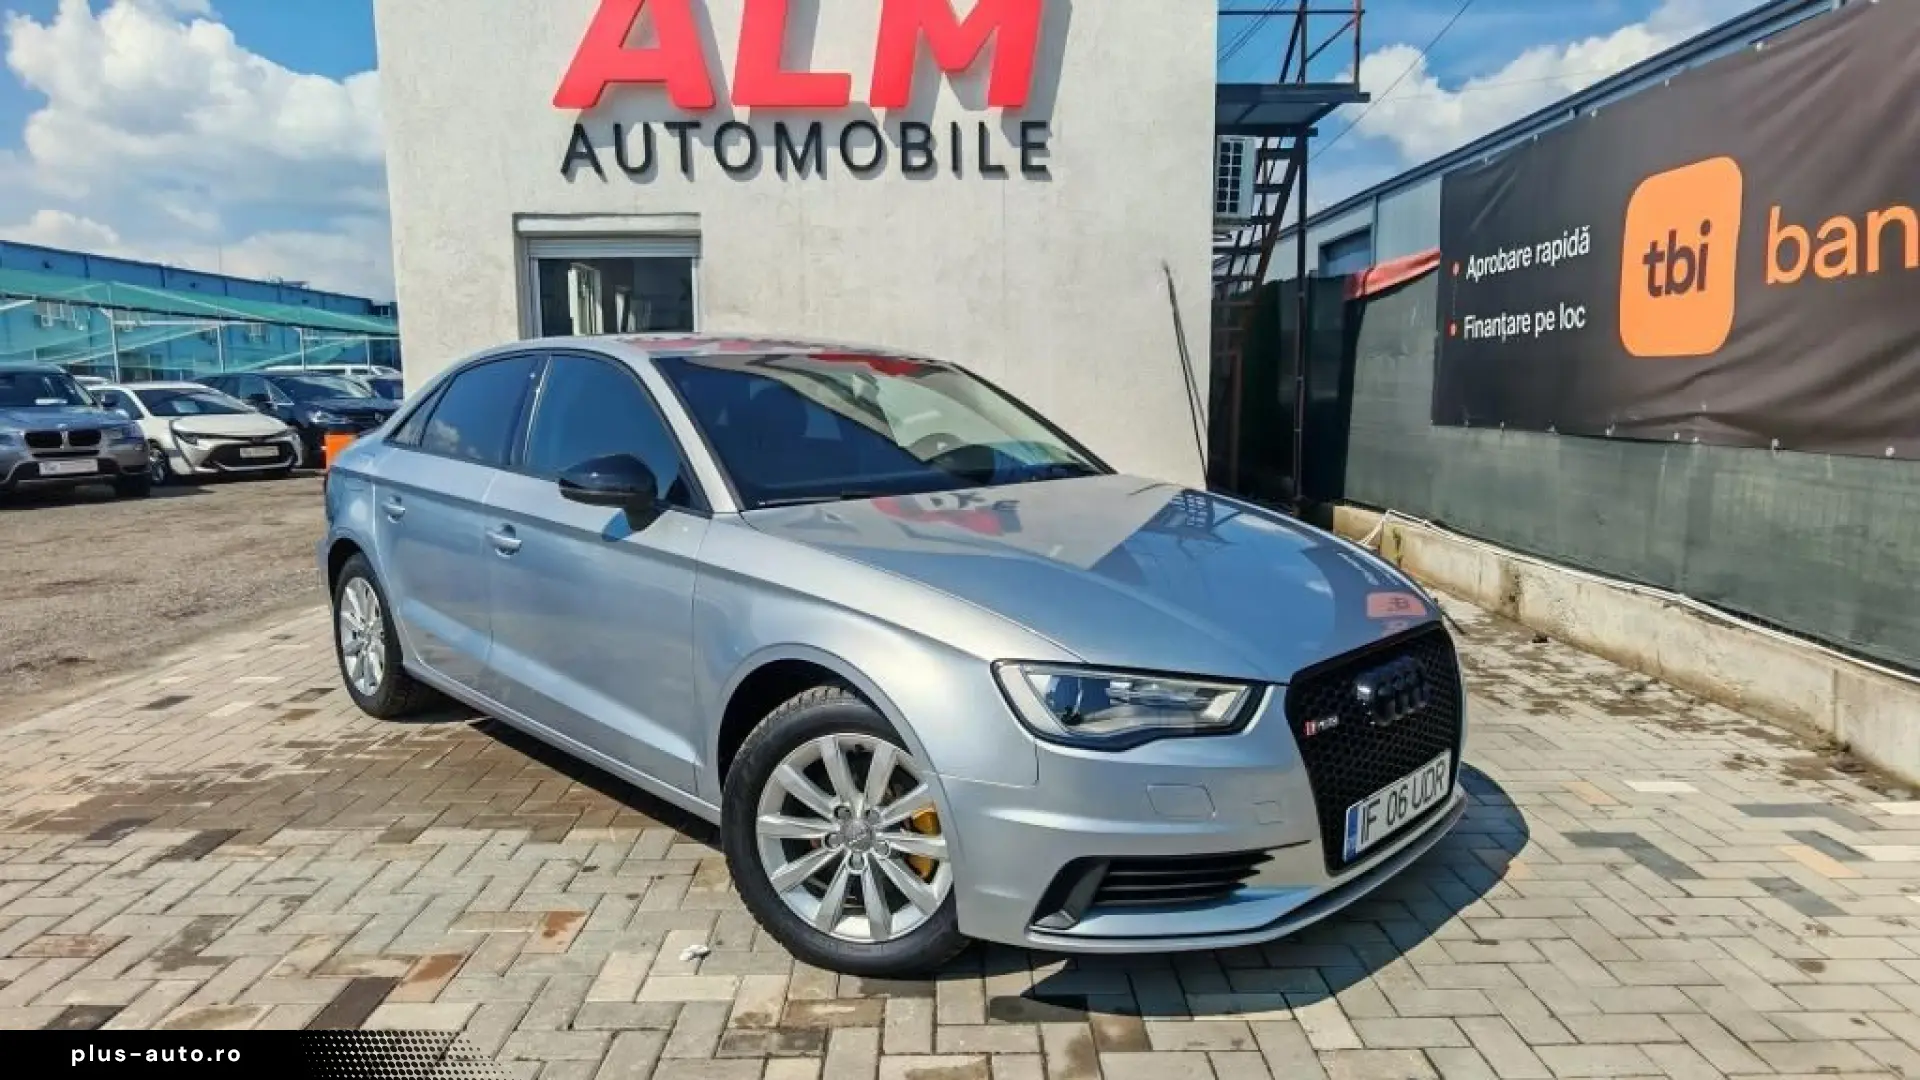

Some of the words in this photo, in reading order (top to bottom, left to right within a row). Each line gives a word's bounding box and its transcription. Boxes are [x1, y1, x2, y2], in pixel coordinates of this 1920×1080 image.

[553, 0, 1043, 110] ALM
[559, 119, 1050, 175] AUTOMOBILE
[1465, 247, 1533, 283] Aprobare
[1535, 224, 1591, 267] rapidă
[1642, 218, 1712, 297] tbi
[1534, 309, 1555, 338] pe
[1559, 301, 1586, 330] loc
[1360, 798, 1380, 845] IF
[1387, 783, 1408, 826] 06
[1411, 760, 1446, 811] UDR
